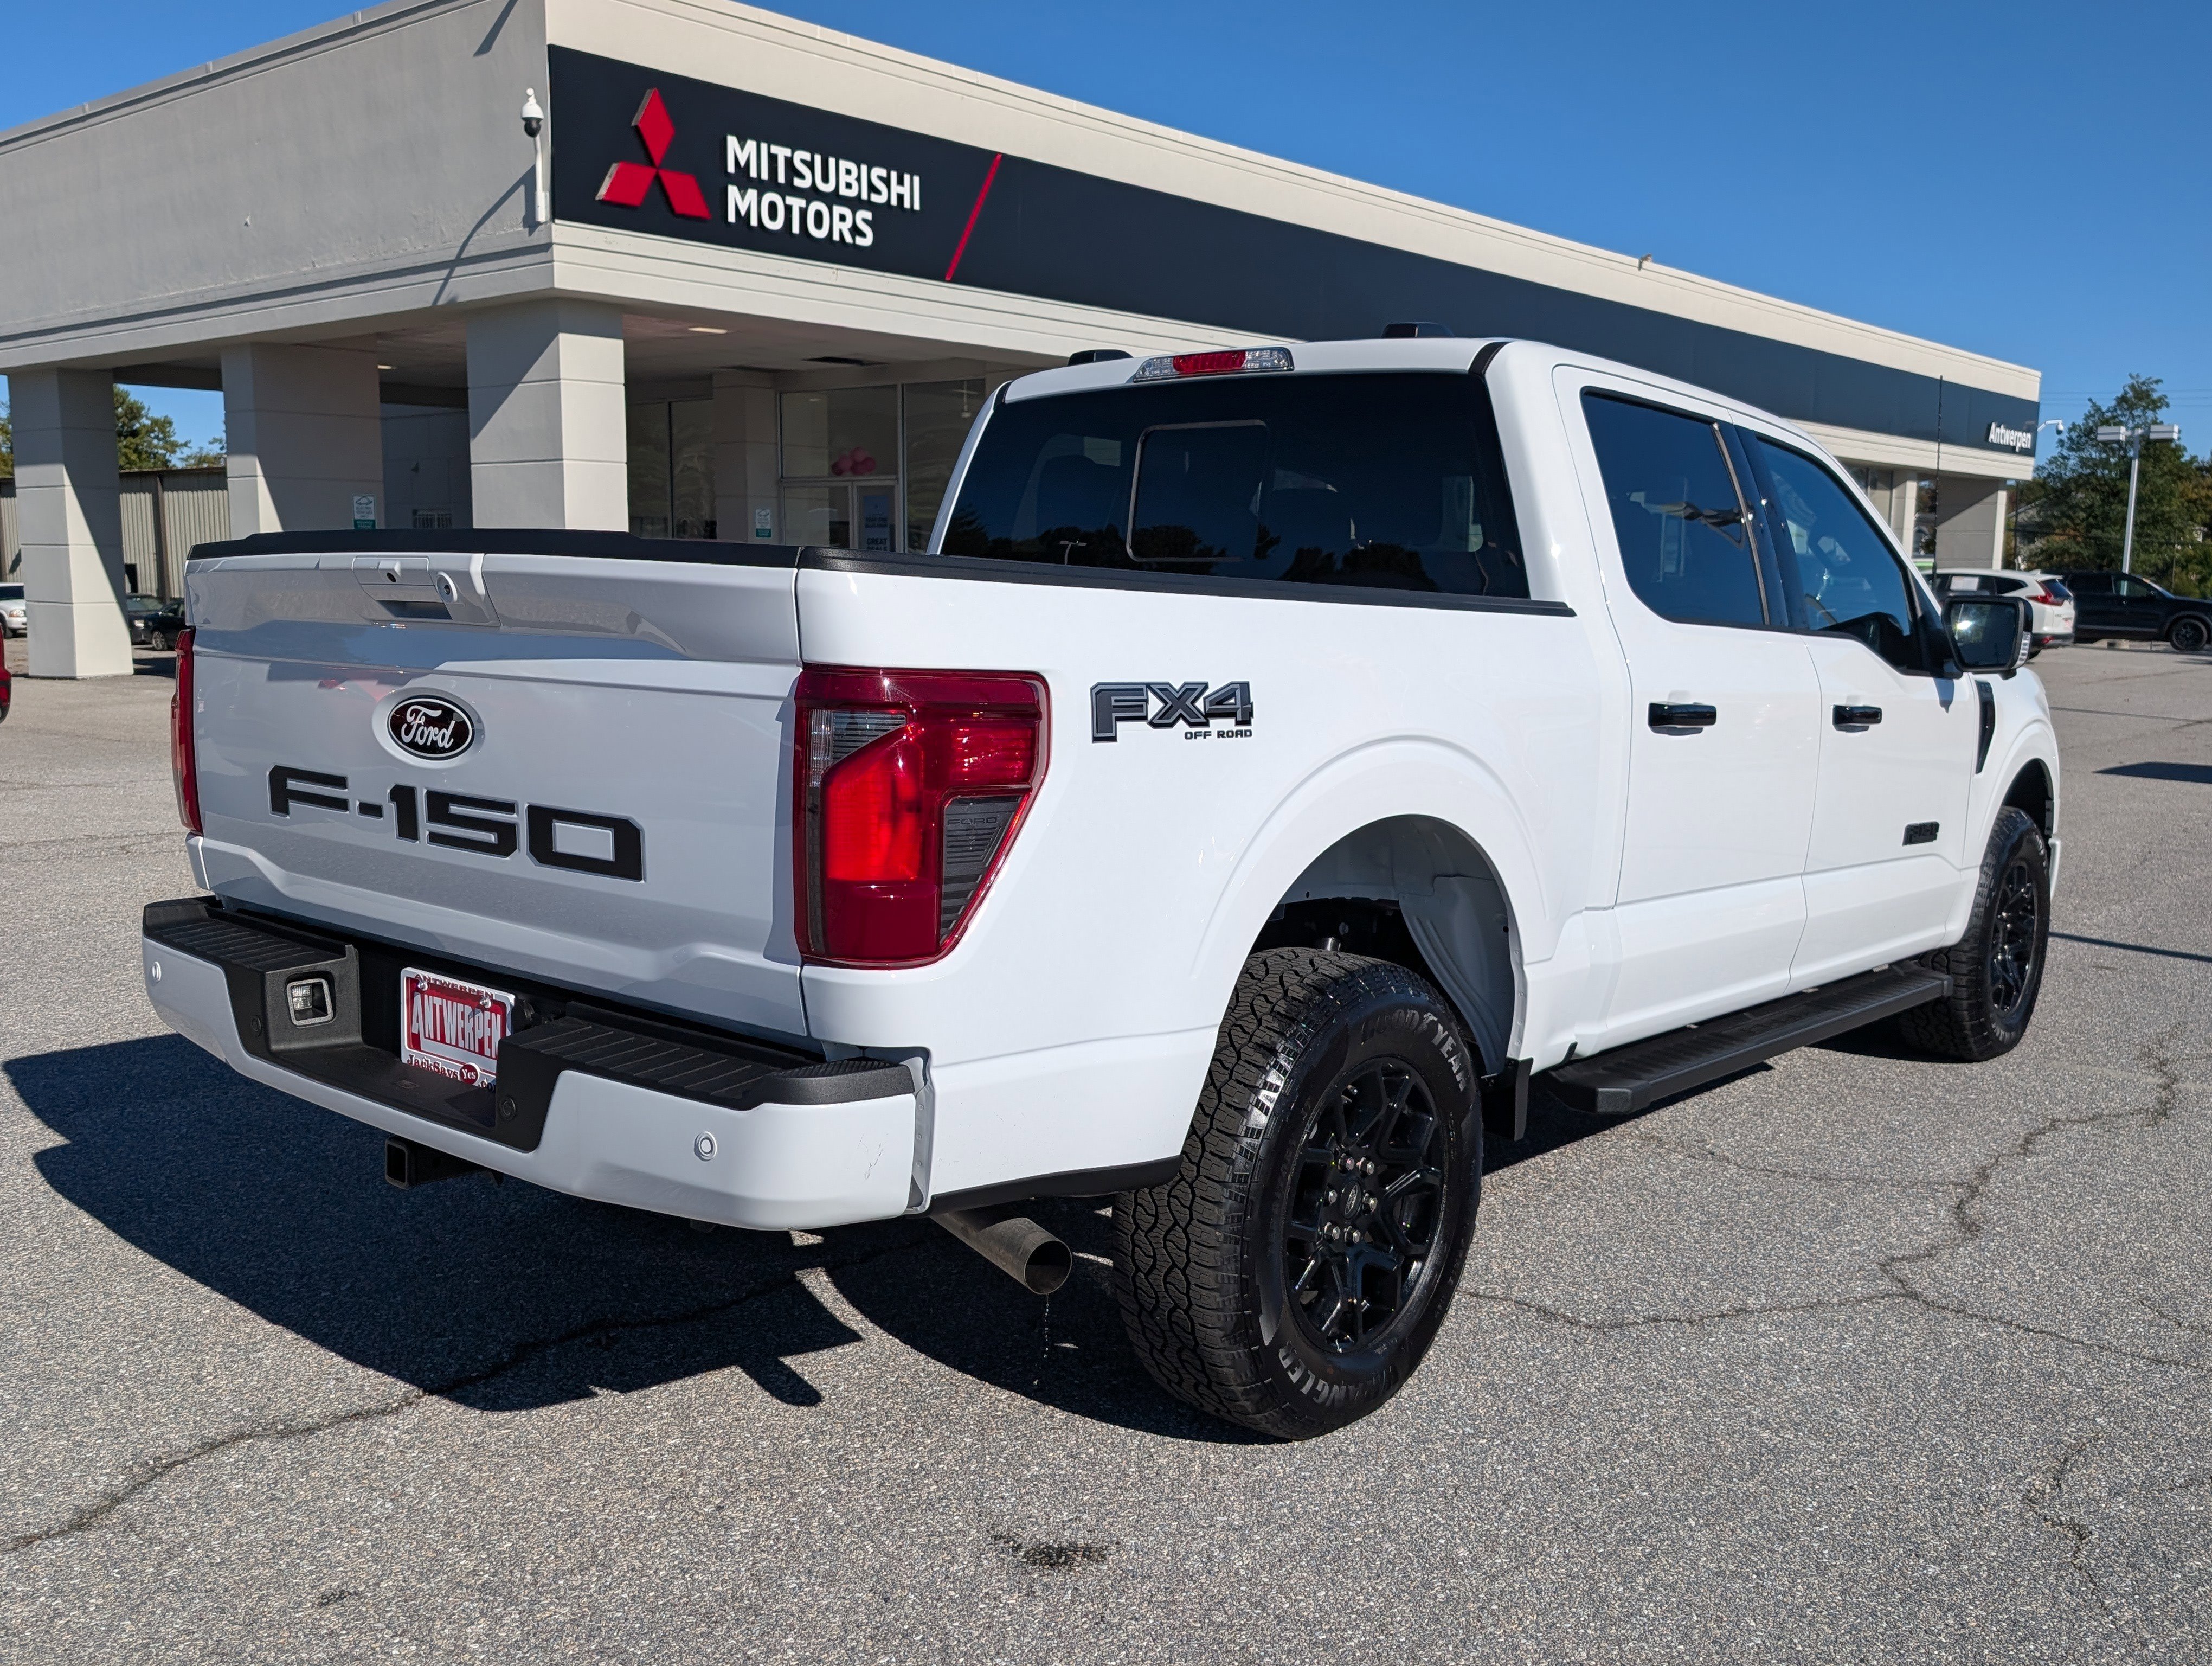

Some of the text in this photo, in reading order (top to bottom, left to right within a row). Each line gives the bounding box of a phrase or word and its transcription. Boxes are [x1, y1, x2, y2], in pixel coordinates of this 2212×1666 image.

[726, 134, 921, 211] MITSUBISHI
[726, 184, 873, 247] MOTORS
[1989, 421, 2032, 452] Antwerpen
[400, 705, 456, 749] Ford
[1090, 681, 1254, 743] FX4
[1184, 729, 1253, 740] OFF ROAD
[268, 764, 646, 883] F-150
[947, 817, 998, 825] FORD
[415, 974, 495, 999] ANTWERPEN
[411, 991, 501, 1058] ANTWERPEN
